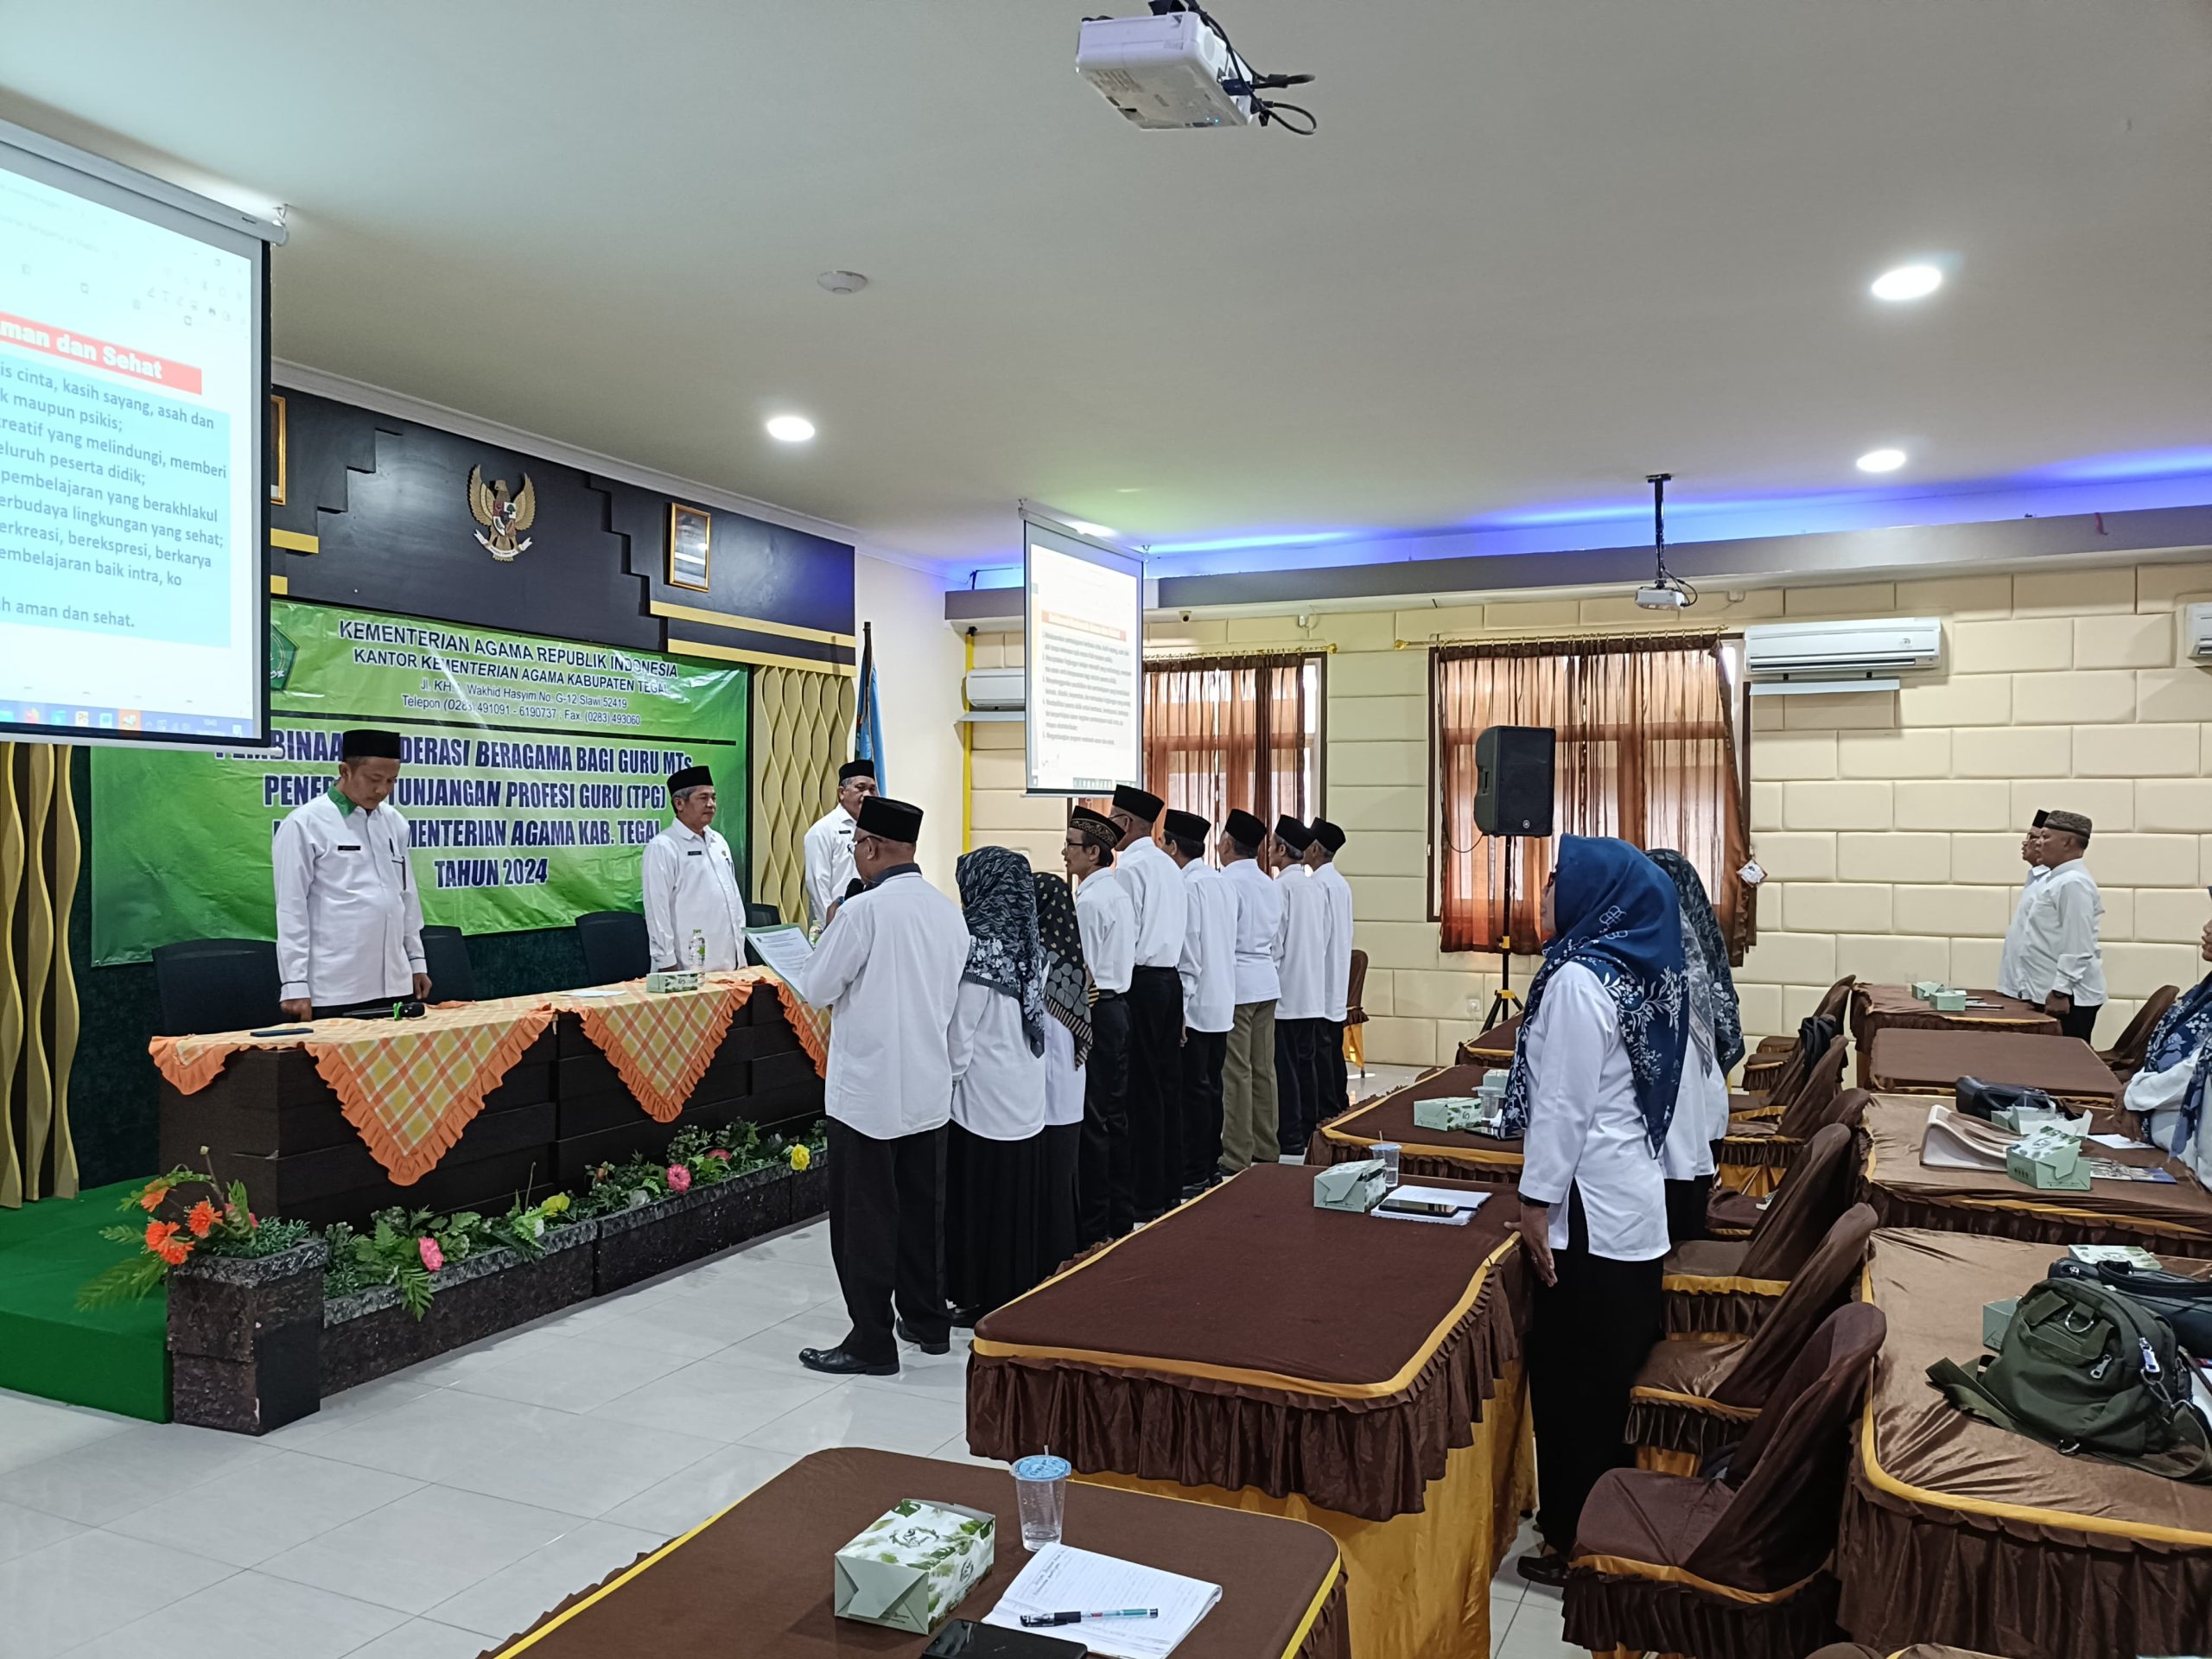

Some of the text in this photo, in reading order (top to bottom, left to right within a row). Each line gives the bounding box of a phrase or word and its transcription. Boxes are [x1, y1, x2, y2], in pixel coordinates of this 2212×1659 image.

[0, 321, 162, 379] man dan Sehat
[14, 394, 75, 419] maupun
[79, 410, 123, 433] psikis;
[17, 367, 58, 392] cinta,
[63, 378, 99, 400] kasih
[104, 391, 154, 416] sayang,
[158, 404, 187, 423] asah
[191, 412, 214, 429] dan
[0, 417, 226, 479] reatif yang melindungi, memberi
[0, 441, 145, 486] eluruh peserta didik;
[1, 469, 218, 522] pembelajaran yang berakhlakul
[0, 494, 224, 549] erbudaya lingkungan yang sehat;
[0, 520, 212, 569] erkreasi, berekspresi, berkarya
[0, 547, 181, 587] embelajaran baik intra, ko
[16, 601, 58, 618] aman
[62, 604, 89, 622] dan
[93, 610, 135, 627] sehat.
[340, 620, 677, 677] KEMENTERIAN AGAMA REPUBLIK INDONESIA
[354, 649, 417, 668] KANTOR
[422, 655, 518, 680] KEMENTERIAN
[522, 668, 564, 684] AGAMA
[567, 674, 634, 691] KABUPATEN
[402, 695, 441, 709] Telepon
[477, 702, 510, 715] 491091
[519, 706, 556, 719] 6190737
[585, 711, 610, 724] (0283)
[612, 714, 641, 725] 493060
[467, 683, 501, 698] Wakhid
[504, 688, 537, 702] Hasyim
[556, 692, 577, 704] G-12
[580, 695, 601, 706] Slawi
[603, 698, 627, 709] 52419
[400, 736, 471, 766] DERASI
[475, 741, 572, 771] BERAGAMA
[576, 747, 614, 772] BAGI
[618, 748, 659, 774] GURU
[505, 782, 575, 809] PROFESI
[580, 785, 623, 809] GURU
[626, 785, 665, 810] (TPG)
[511, 820, 575, 846] AGAMA
[579, 820, 614, 845] KAB.
[435, 858, 548, 888] TAHUN 2024
